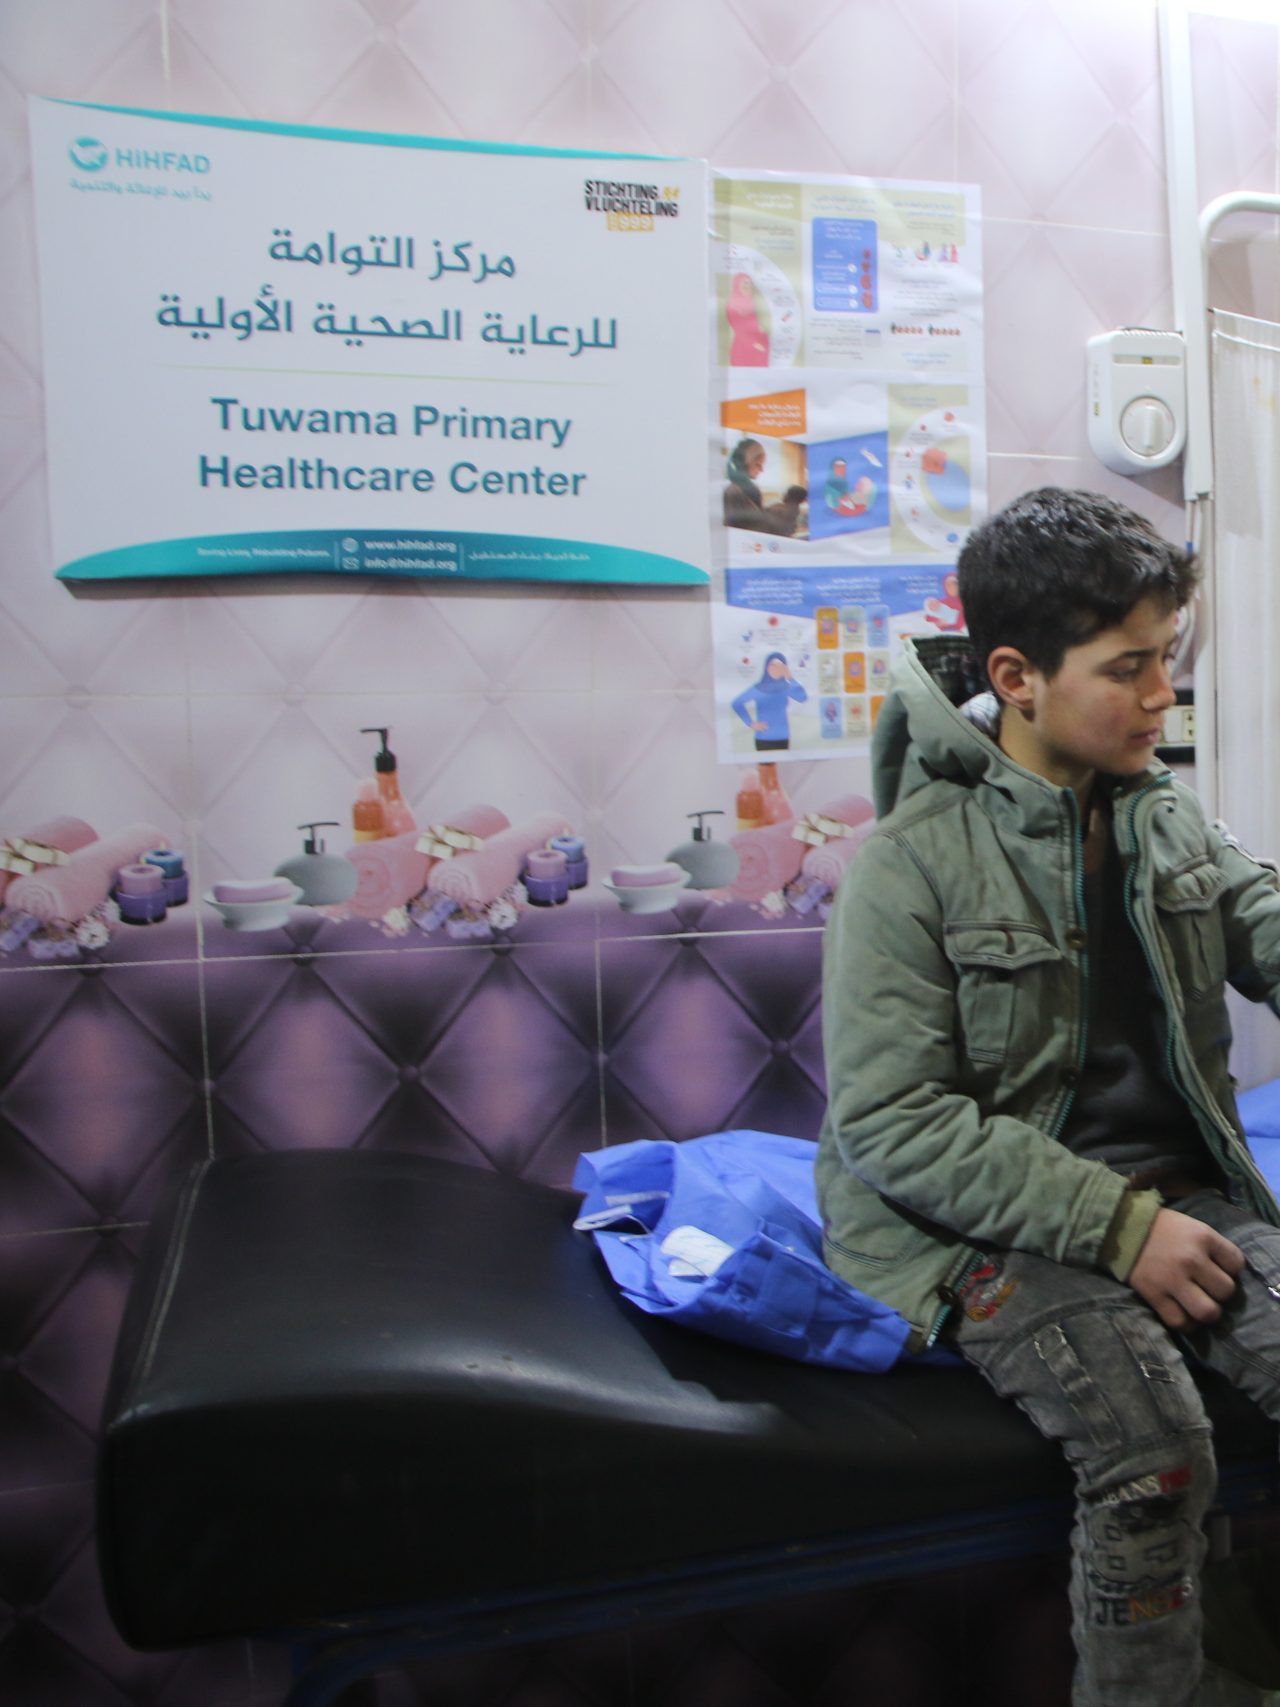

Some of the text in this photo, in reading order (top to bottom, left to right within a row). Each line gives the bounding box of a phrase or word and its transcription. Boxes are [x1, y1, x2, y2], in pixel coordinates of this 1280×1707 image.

[584, 180, 658, 200] STICHTING
[585, 196, 679, 217] VLUCHTELING
[267, 228, 516, 284] مركز التوامة
[155, 284, 618, 357] للرعاية الصحية الأولية
[209, 396, 572, 449] Tuwama Primary
[198, 454, 587, 496] Healthcare Center
